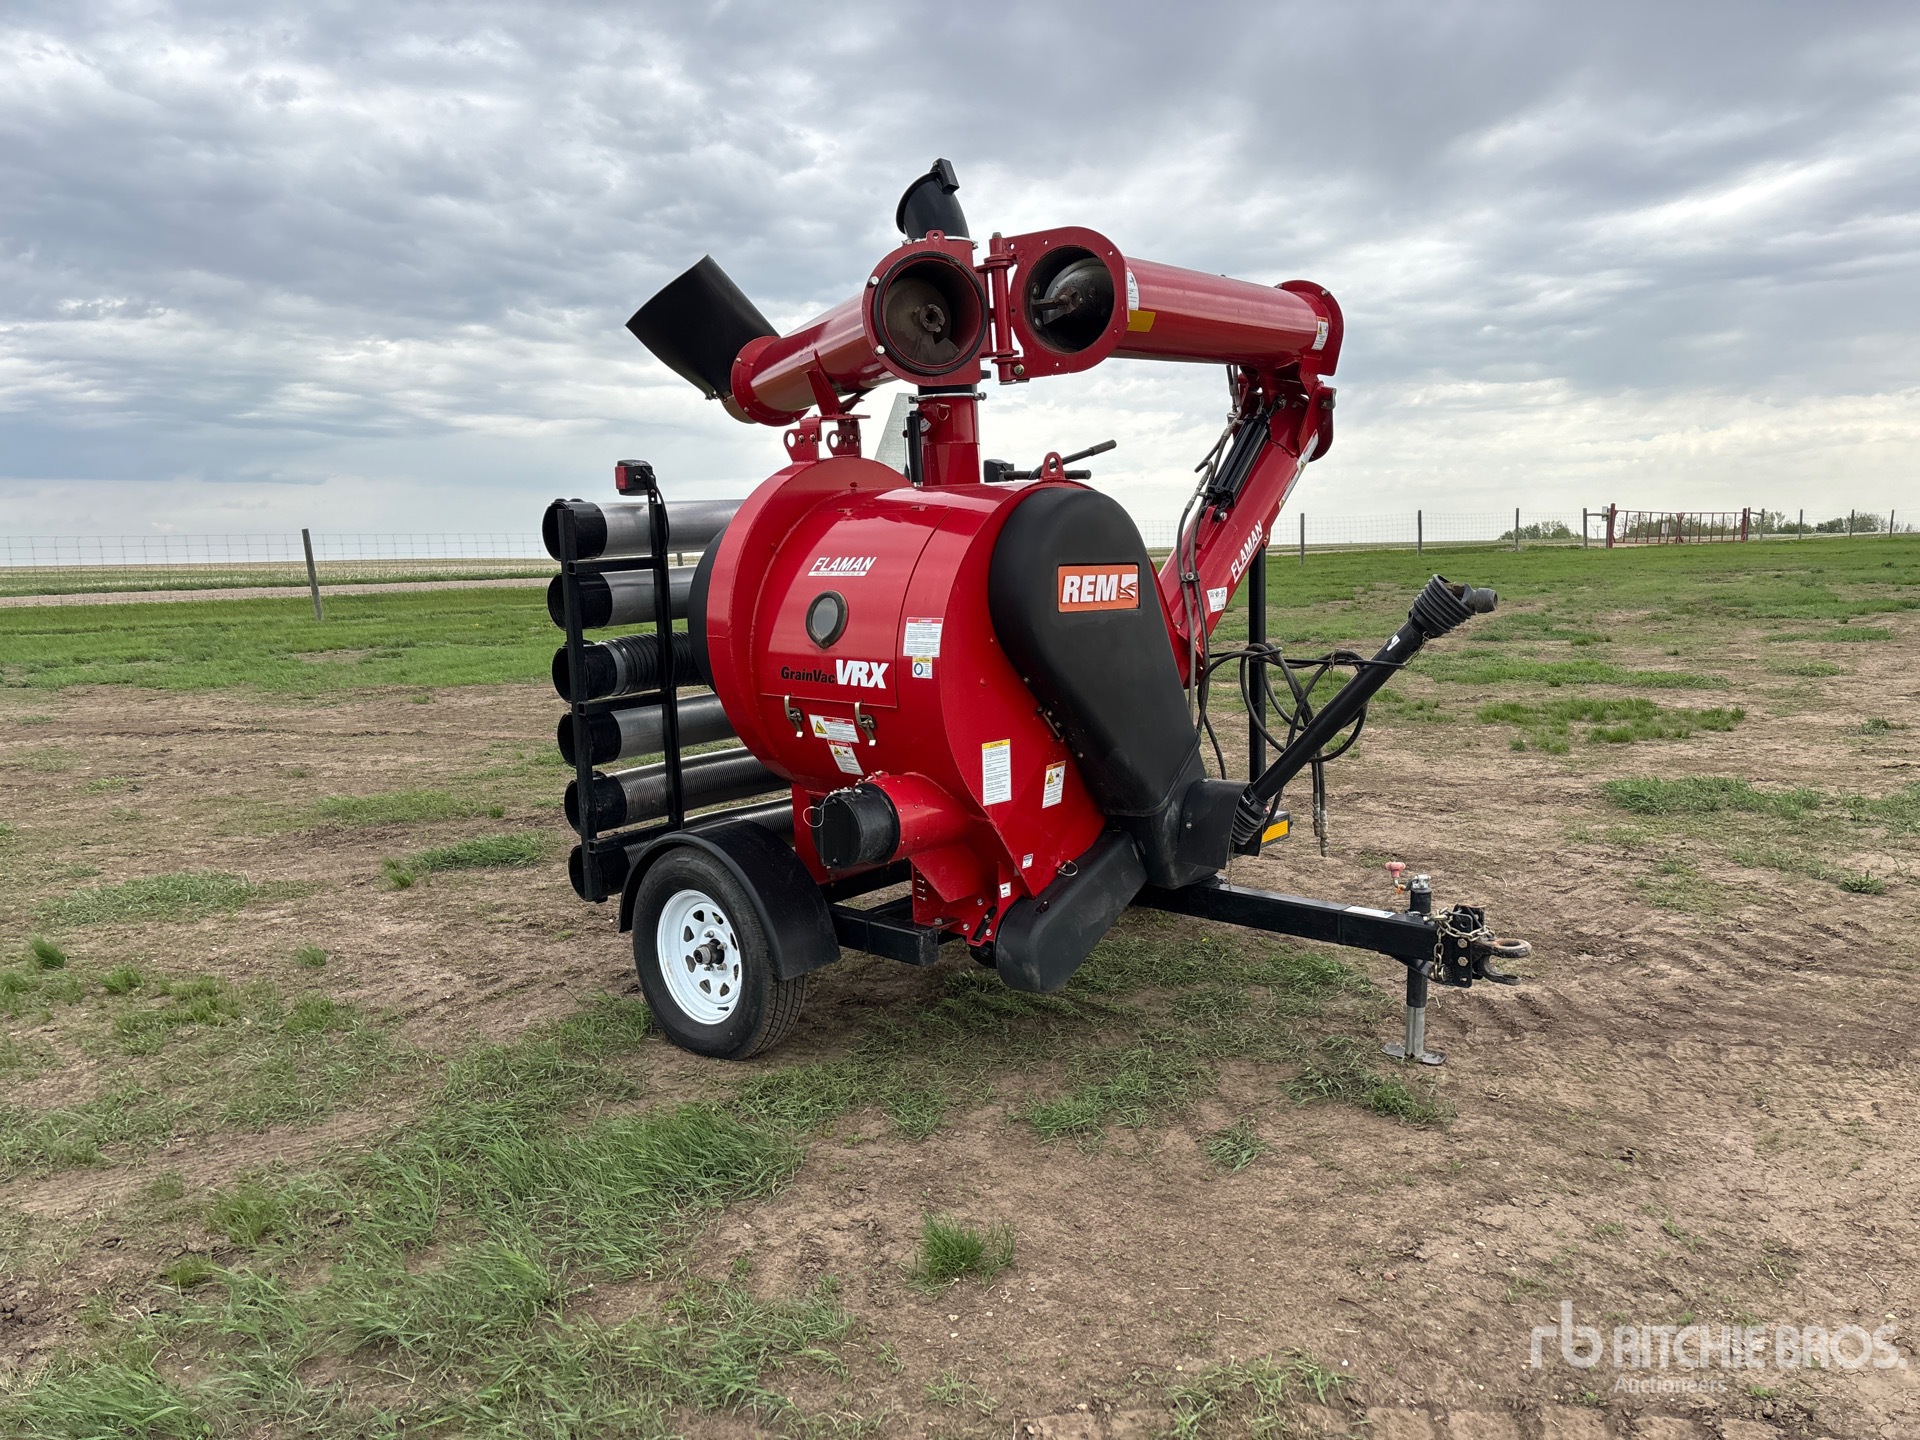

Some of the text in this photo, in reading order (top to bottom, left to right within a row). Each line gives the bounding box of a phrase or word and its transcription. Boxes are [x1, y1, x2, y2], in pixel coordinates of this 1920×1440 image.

[811, 556, 877, 572] FLAMAN
[1230, 520, 1263, 579] FLAMAN
[1061, 574, 1119, 603] REM
[780, 659, 889, 689] GrainVac VRX
